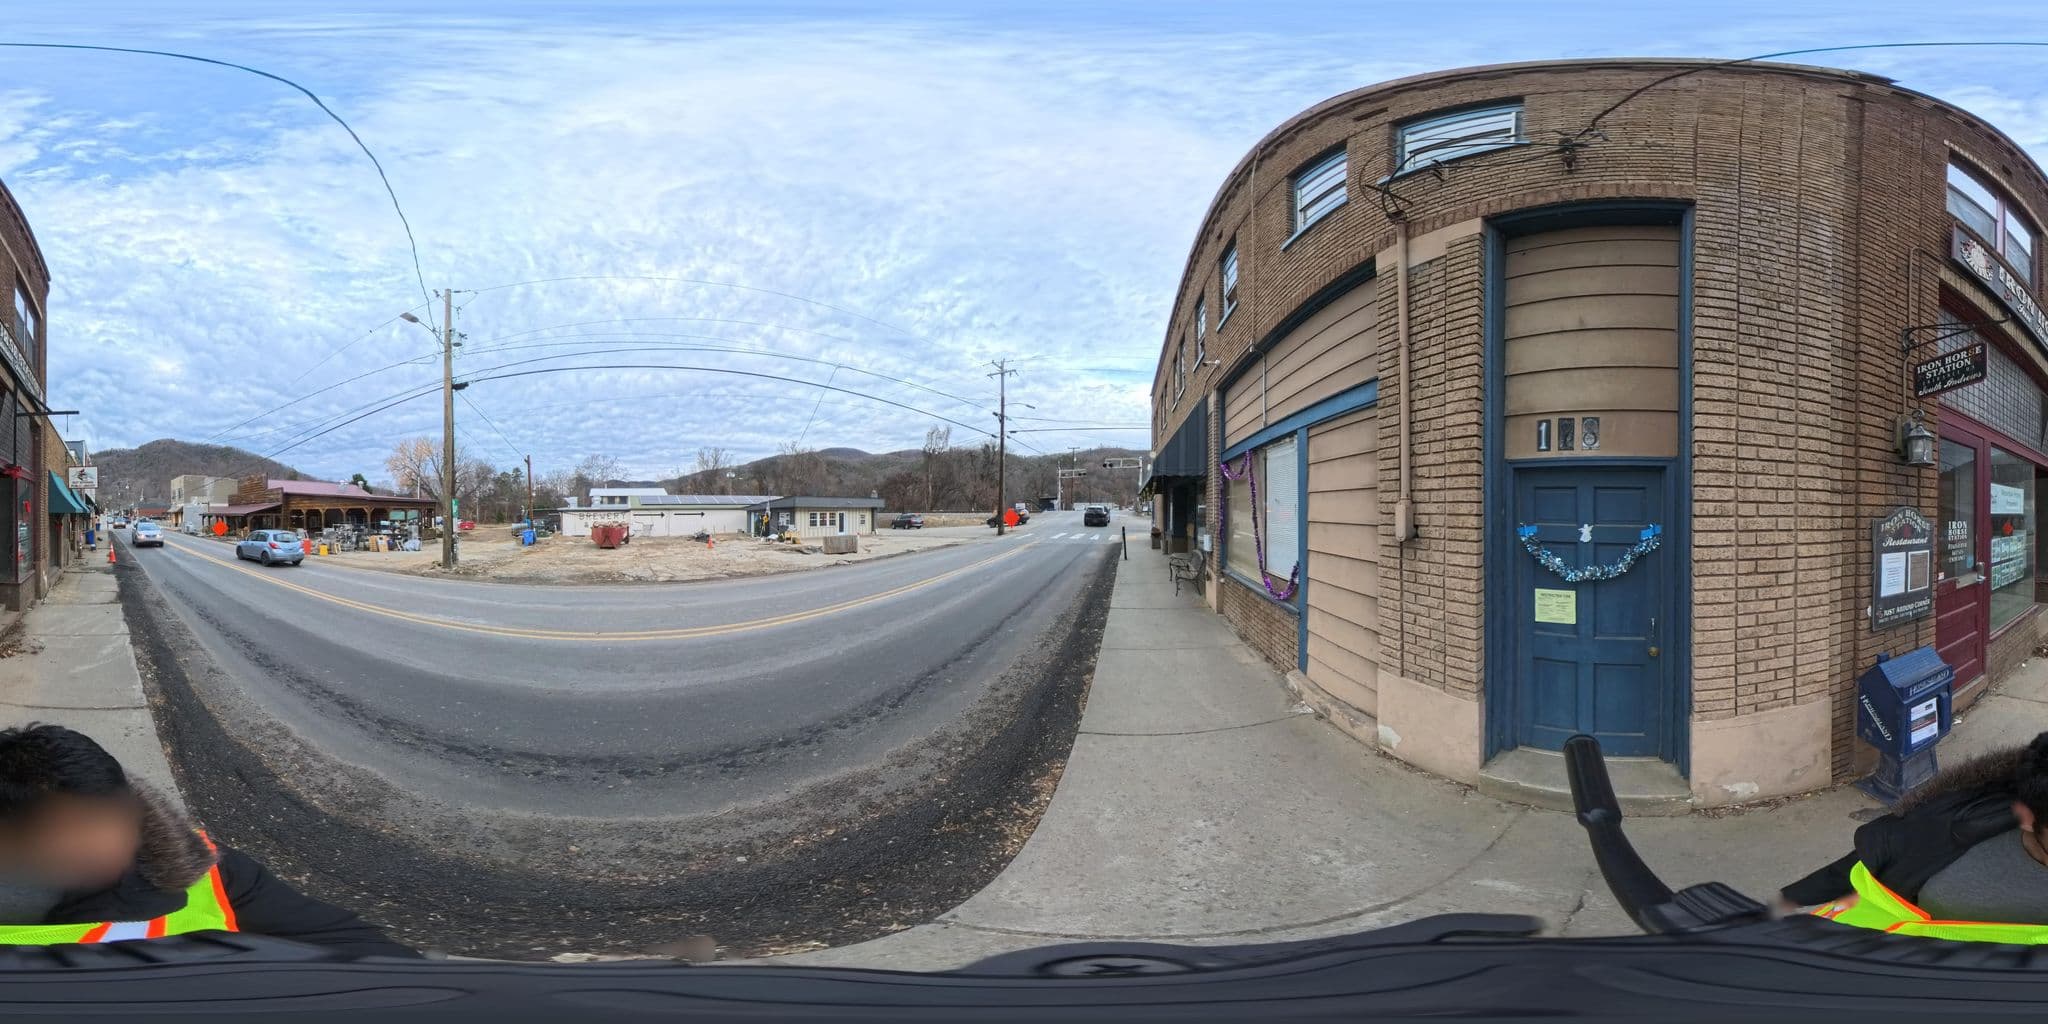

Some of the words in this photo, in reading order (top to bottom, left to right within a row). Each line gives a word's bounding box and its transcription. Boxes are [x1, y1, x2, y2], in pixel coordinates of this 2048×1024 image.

[1999, 264, 2035, 317] IRON
[1917, 359, 1942, 374] IRON
[1945, 345, 1982, 364] HORSE
[1925, 358, 1971, 379] STATION
[578, 512, 625, 520] BREWERY
[1881, 511, 1904, 533] IRON
[1905, 509, 1931, 531] HORSE
[1890, 517, 1921, 534] STATION
[1948, 520, 1968, 529] IRON
[1882, 534, 1929, 547] Restaurant
